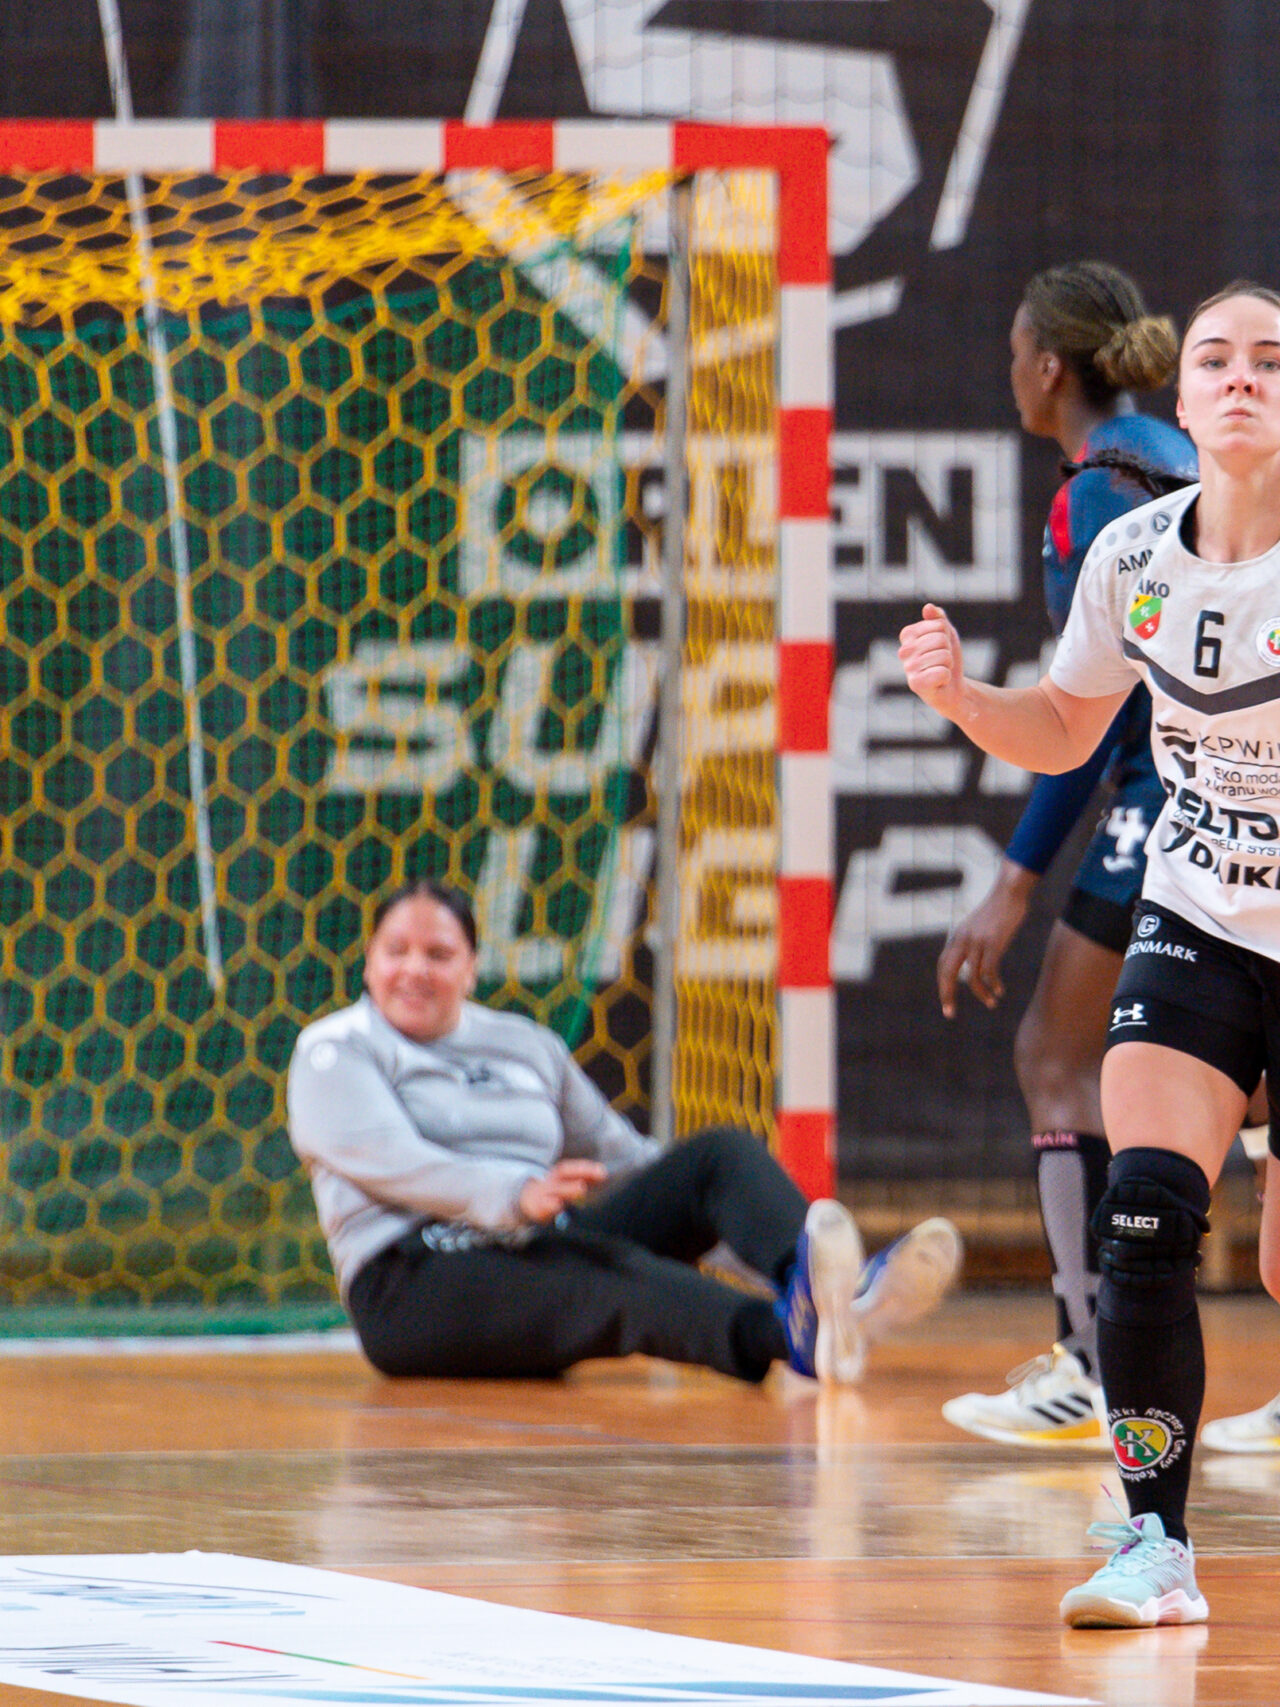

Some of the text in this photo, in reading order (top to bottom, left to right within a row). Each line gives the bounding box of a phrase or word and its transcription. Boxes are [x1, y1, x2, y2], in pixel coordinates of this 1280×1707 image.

[1138, 579, 1170, 599] AKO
[1193, 609, 1225, 679] 6
[325, 638, 1050, 794] SUPE
[1213, 766, 1242, 784] EKO
[1213, 780, 1256, 798] kranu
[1111, 1213, 1160, 1230] SELECT
